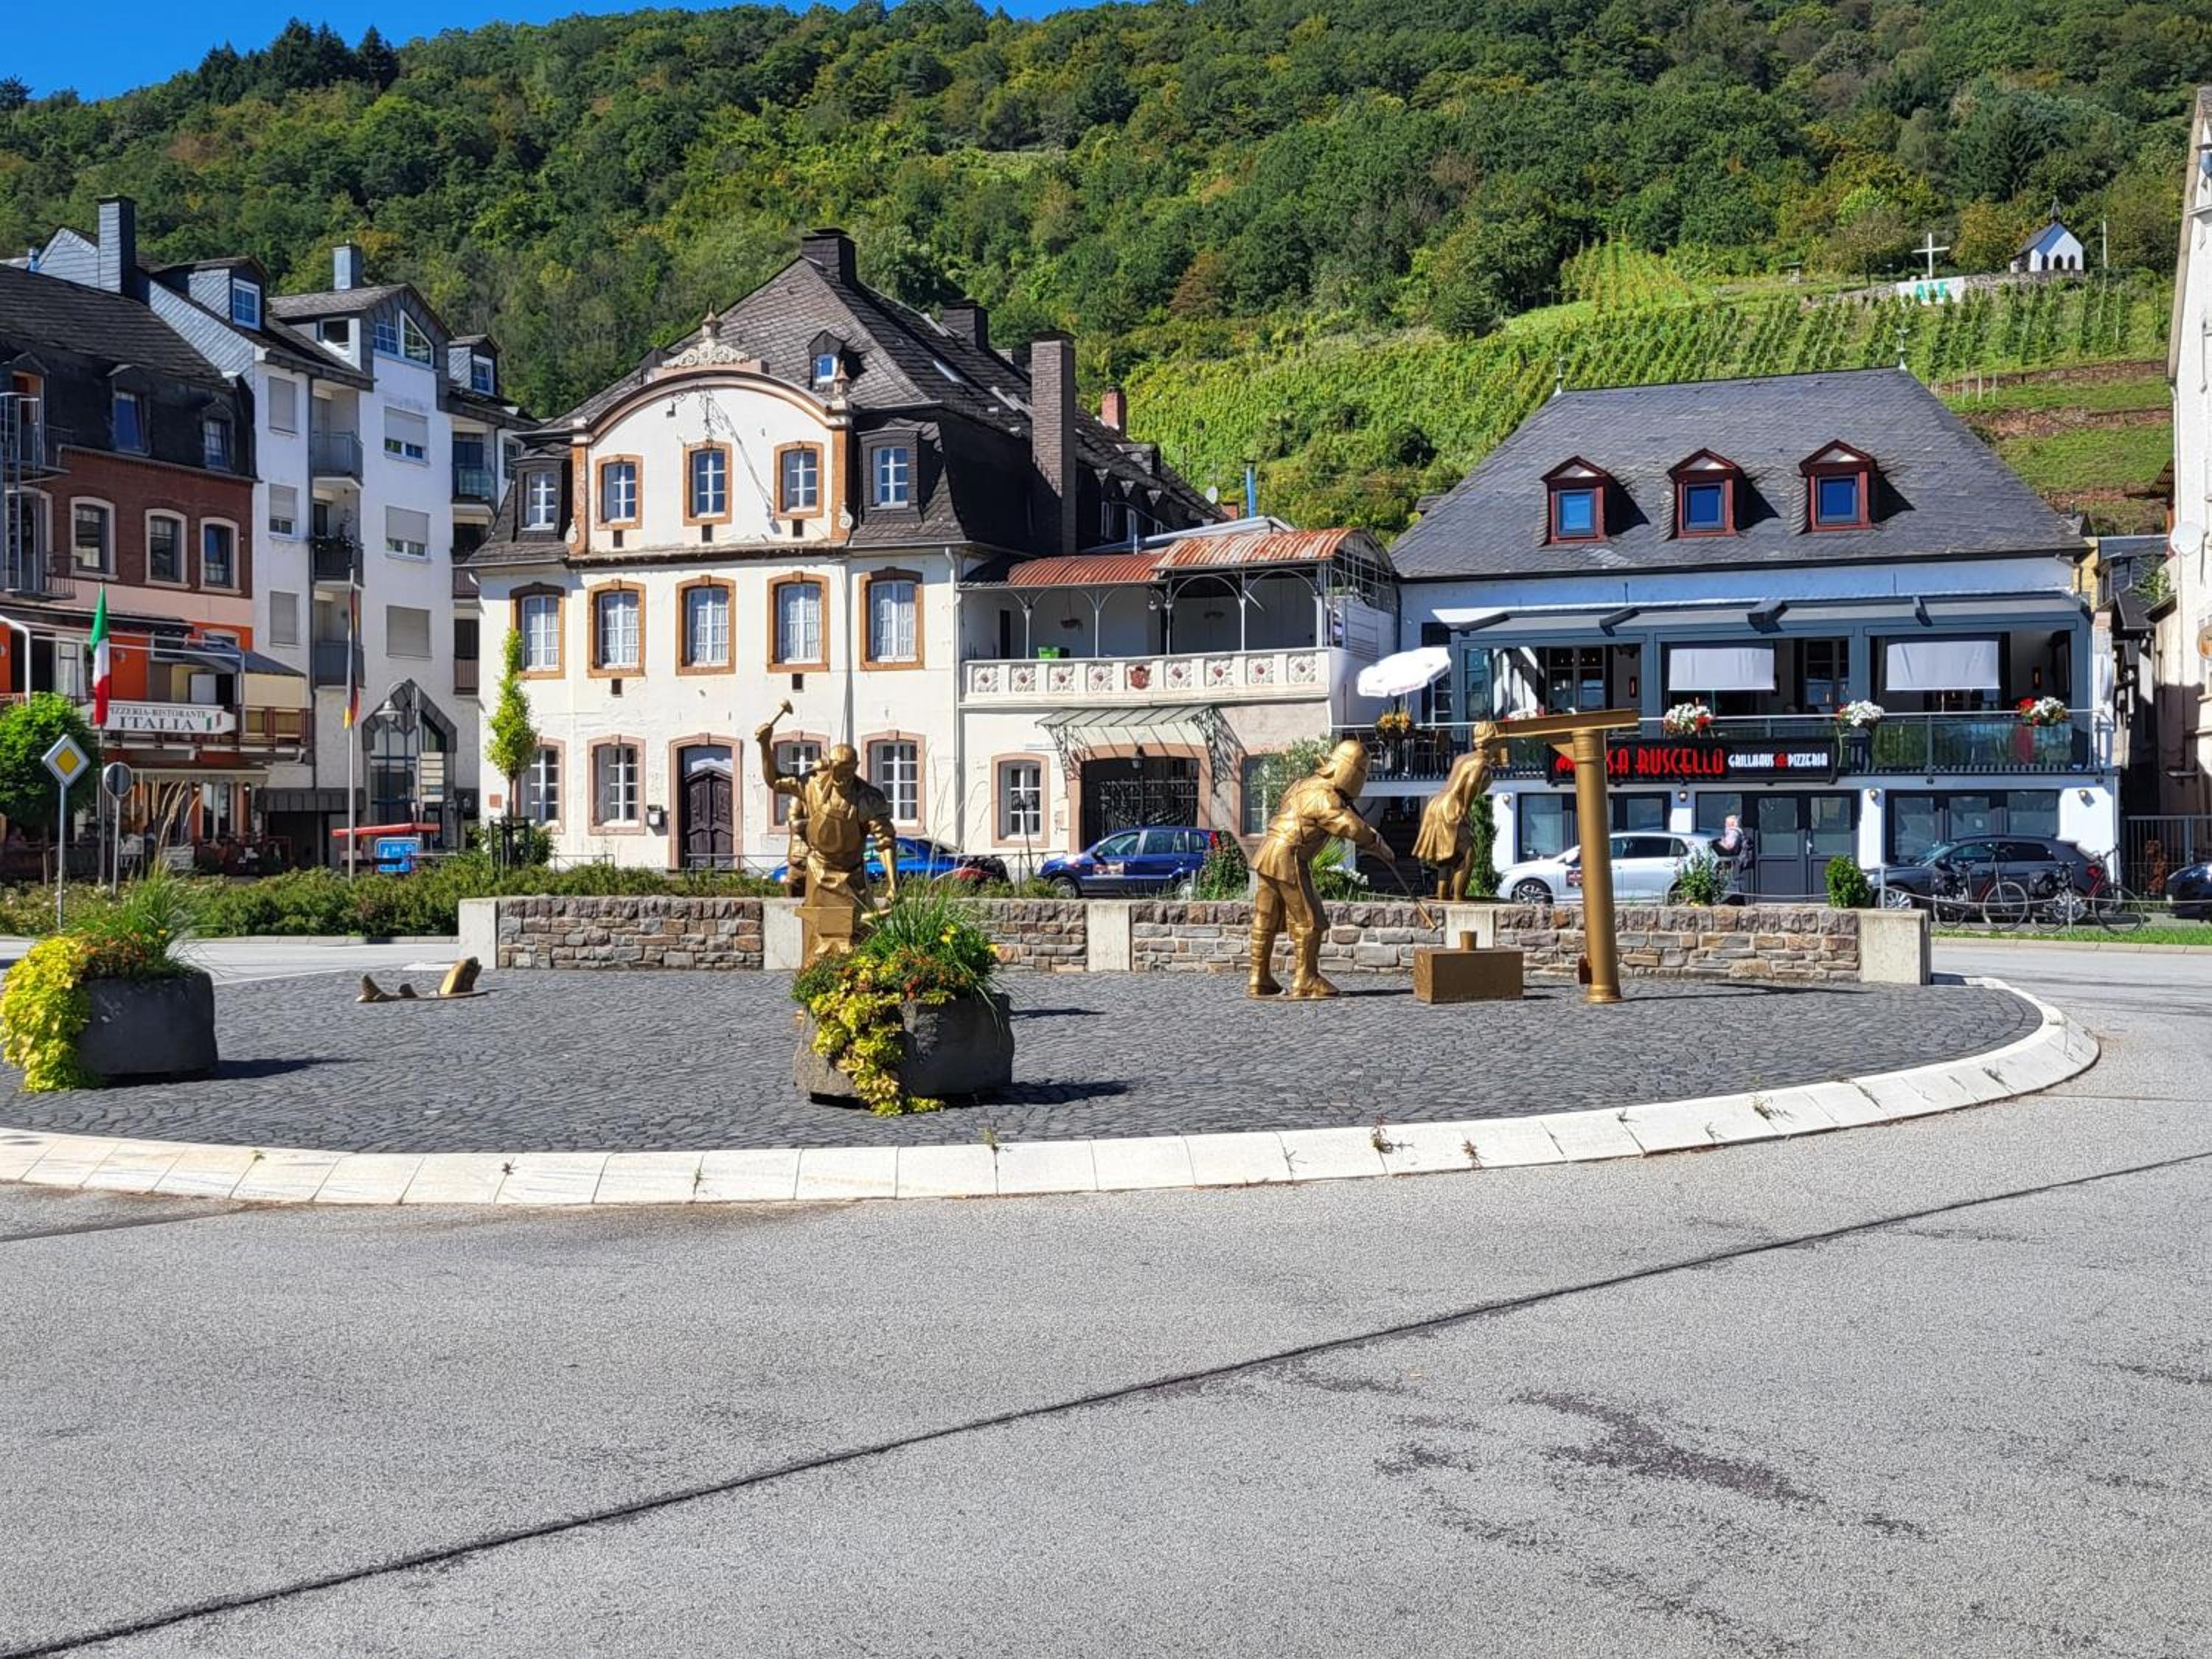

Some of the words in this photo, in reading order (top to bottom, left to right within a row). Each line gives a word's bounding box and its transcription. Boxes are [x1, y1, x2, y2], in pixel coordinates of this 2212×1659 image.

[119, 716, 195, 731] ITALIA
[1606, 748, 1629, 774] SA
[1635, 748, 1724, 774] RUSCELLO
[1788, 753, 1828, 767] PIZZERIA
